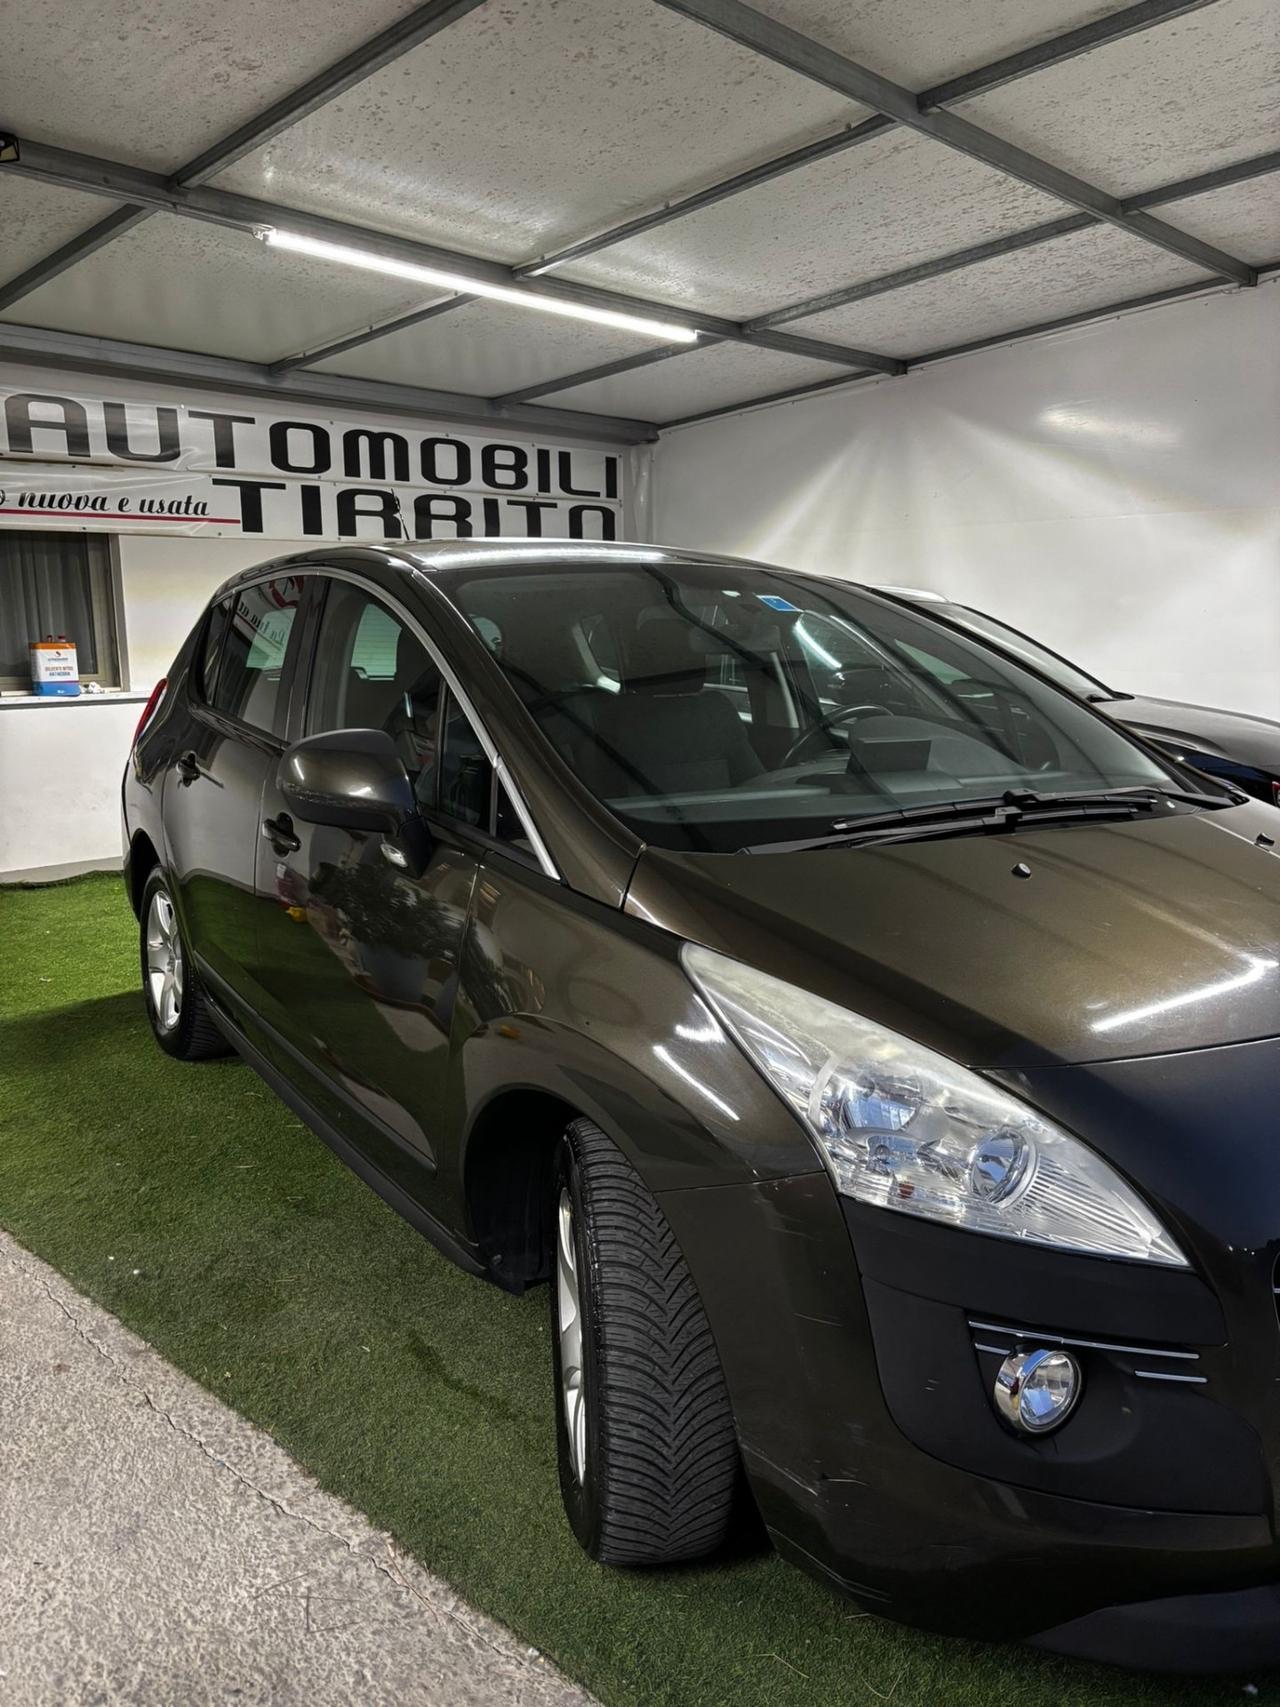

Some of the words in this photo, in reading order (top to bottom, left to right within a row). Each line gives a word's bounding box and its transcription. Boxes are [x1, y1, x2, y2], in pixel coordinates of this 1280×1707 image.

[4, 393, 617, 498] AUTOMOBILI
[18, 491, 110, 512] nuova
[118, 496, 131, 512] e
[138, 495, 210, 516] usata
[212, 478, 615, 541] TIRRITO
